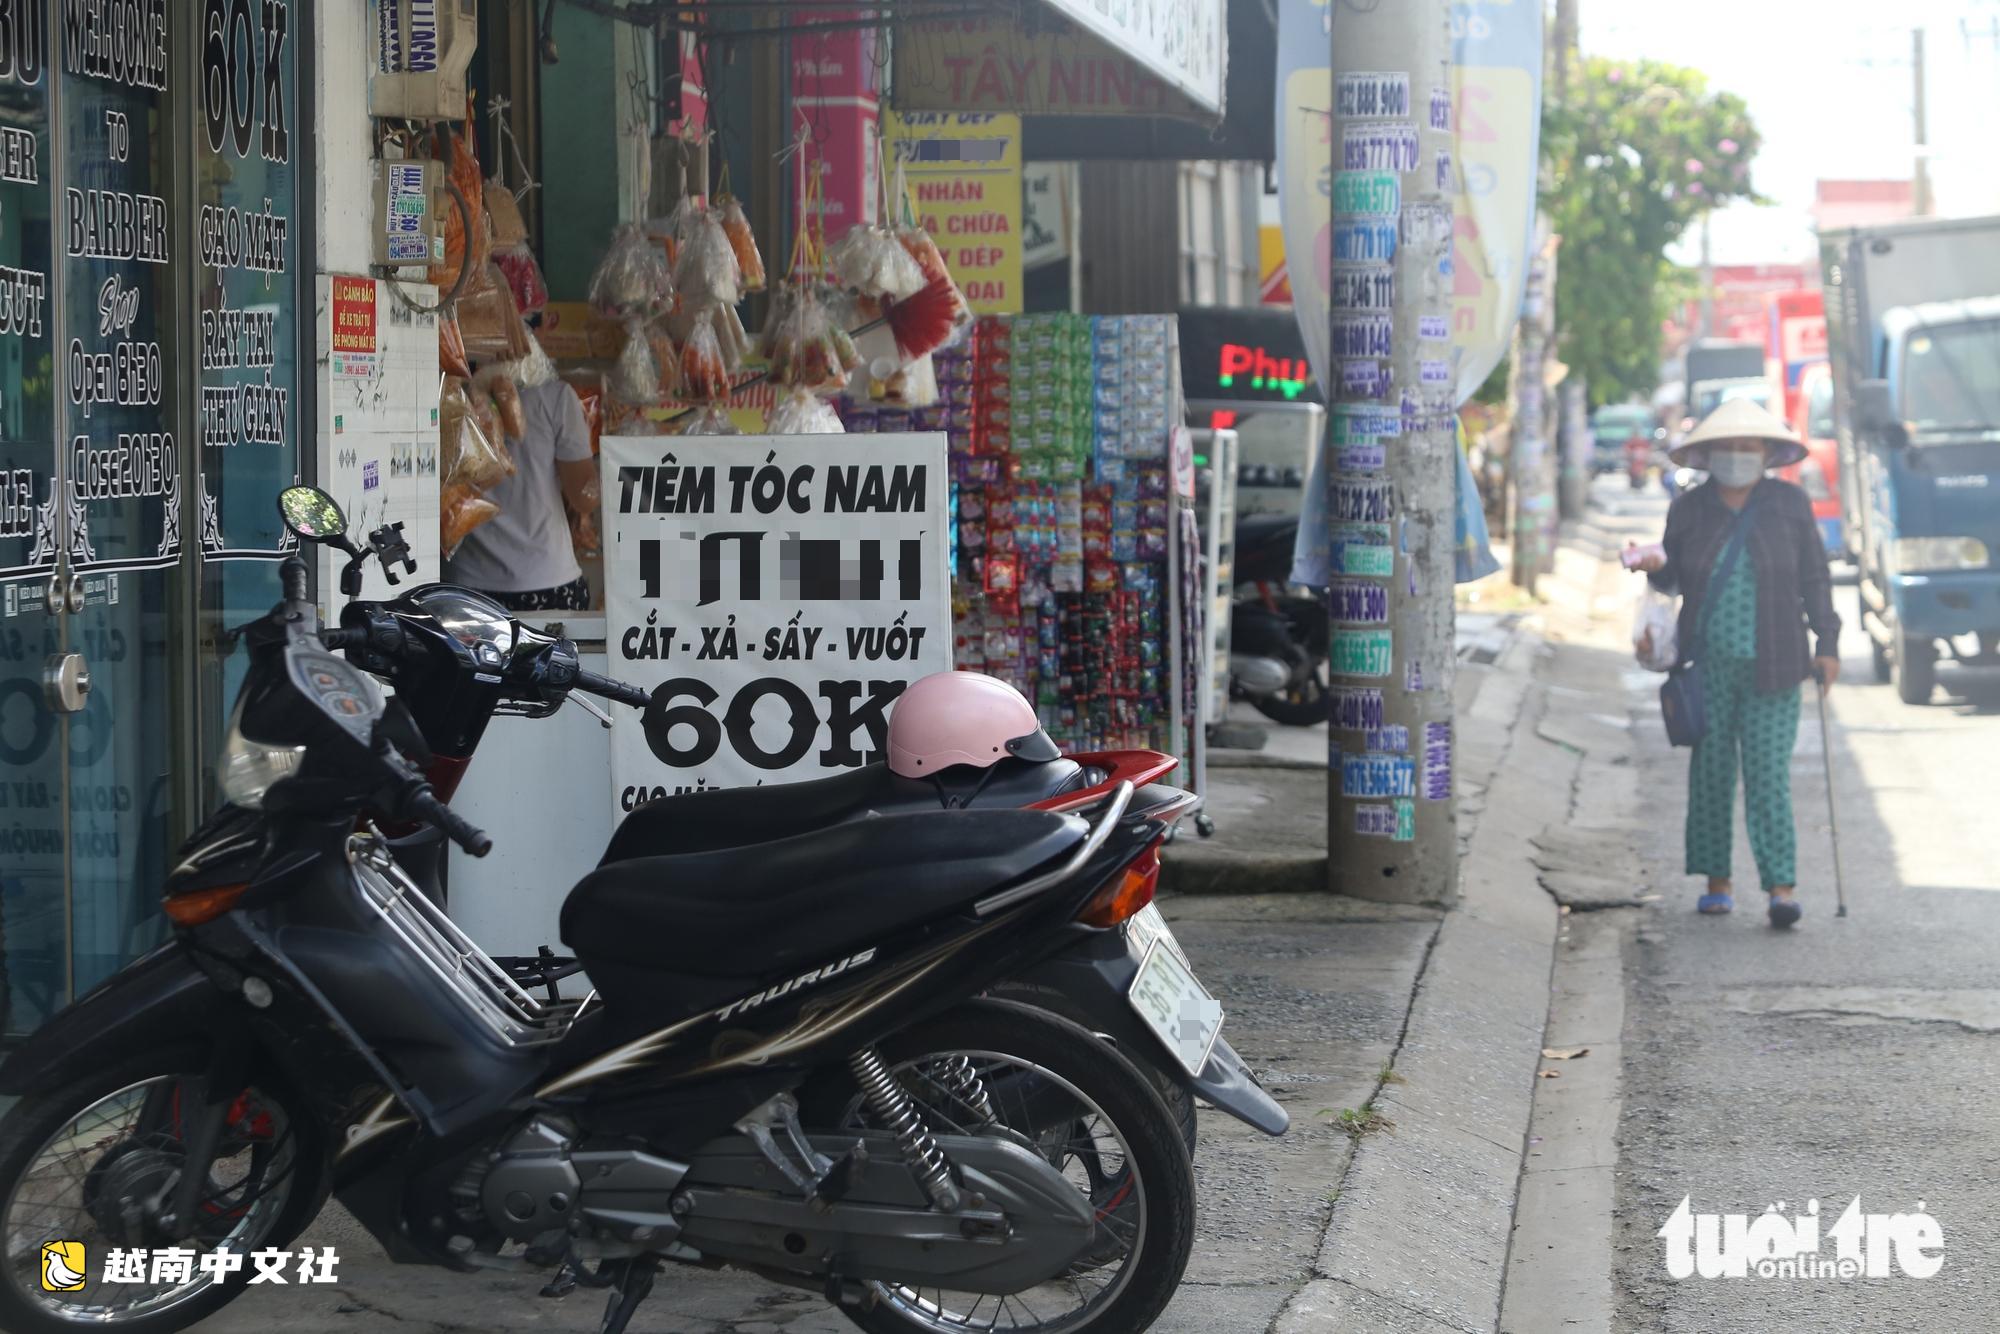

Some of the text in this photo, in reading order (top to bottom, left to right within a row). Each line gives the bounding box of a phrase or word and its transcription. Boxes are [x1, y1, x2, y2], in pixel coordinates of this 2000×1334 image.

[65, 0, 167, 91] WELCOME
[0, 127, 38, 185] ER
[106, 110, 129, 162] TO
[917, 178, 984, 205] NHẬN
[67, 186, 168, 264] BARBER
[200, 198, 287, 290] CẠO MẶT
[97, 273, 140, 339] Shop
[343, 281, 374, 303] CẢNH BÁO
[964, 280, 1006, 307] OẠI
[243, 309, 275, 368] TAI
[69, 338, 114, 418] Open
[202, 380, 242, 446] THƯ
[72, 434, 119, 500] Close
[728, 449, 816, 514] TÓC
[823, 464, 928, 514] NAM
[621, 608, 678, 662] CẮT
[696, 614, 740, 662] XẢ
[762, 609, 824, 662] SẤY
[846, 609, 928, 662] VUỐT
[639, 677, 908, 770] 60K
[714, 946, 877, 1023] TAURUS
